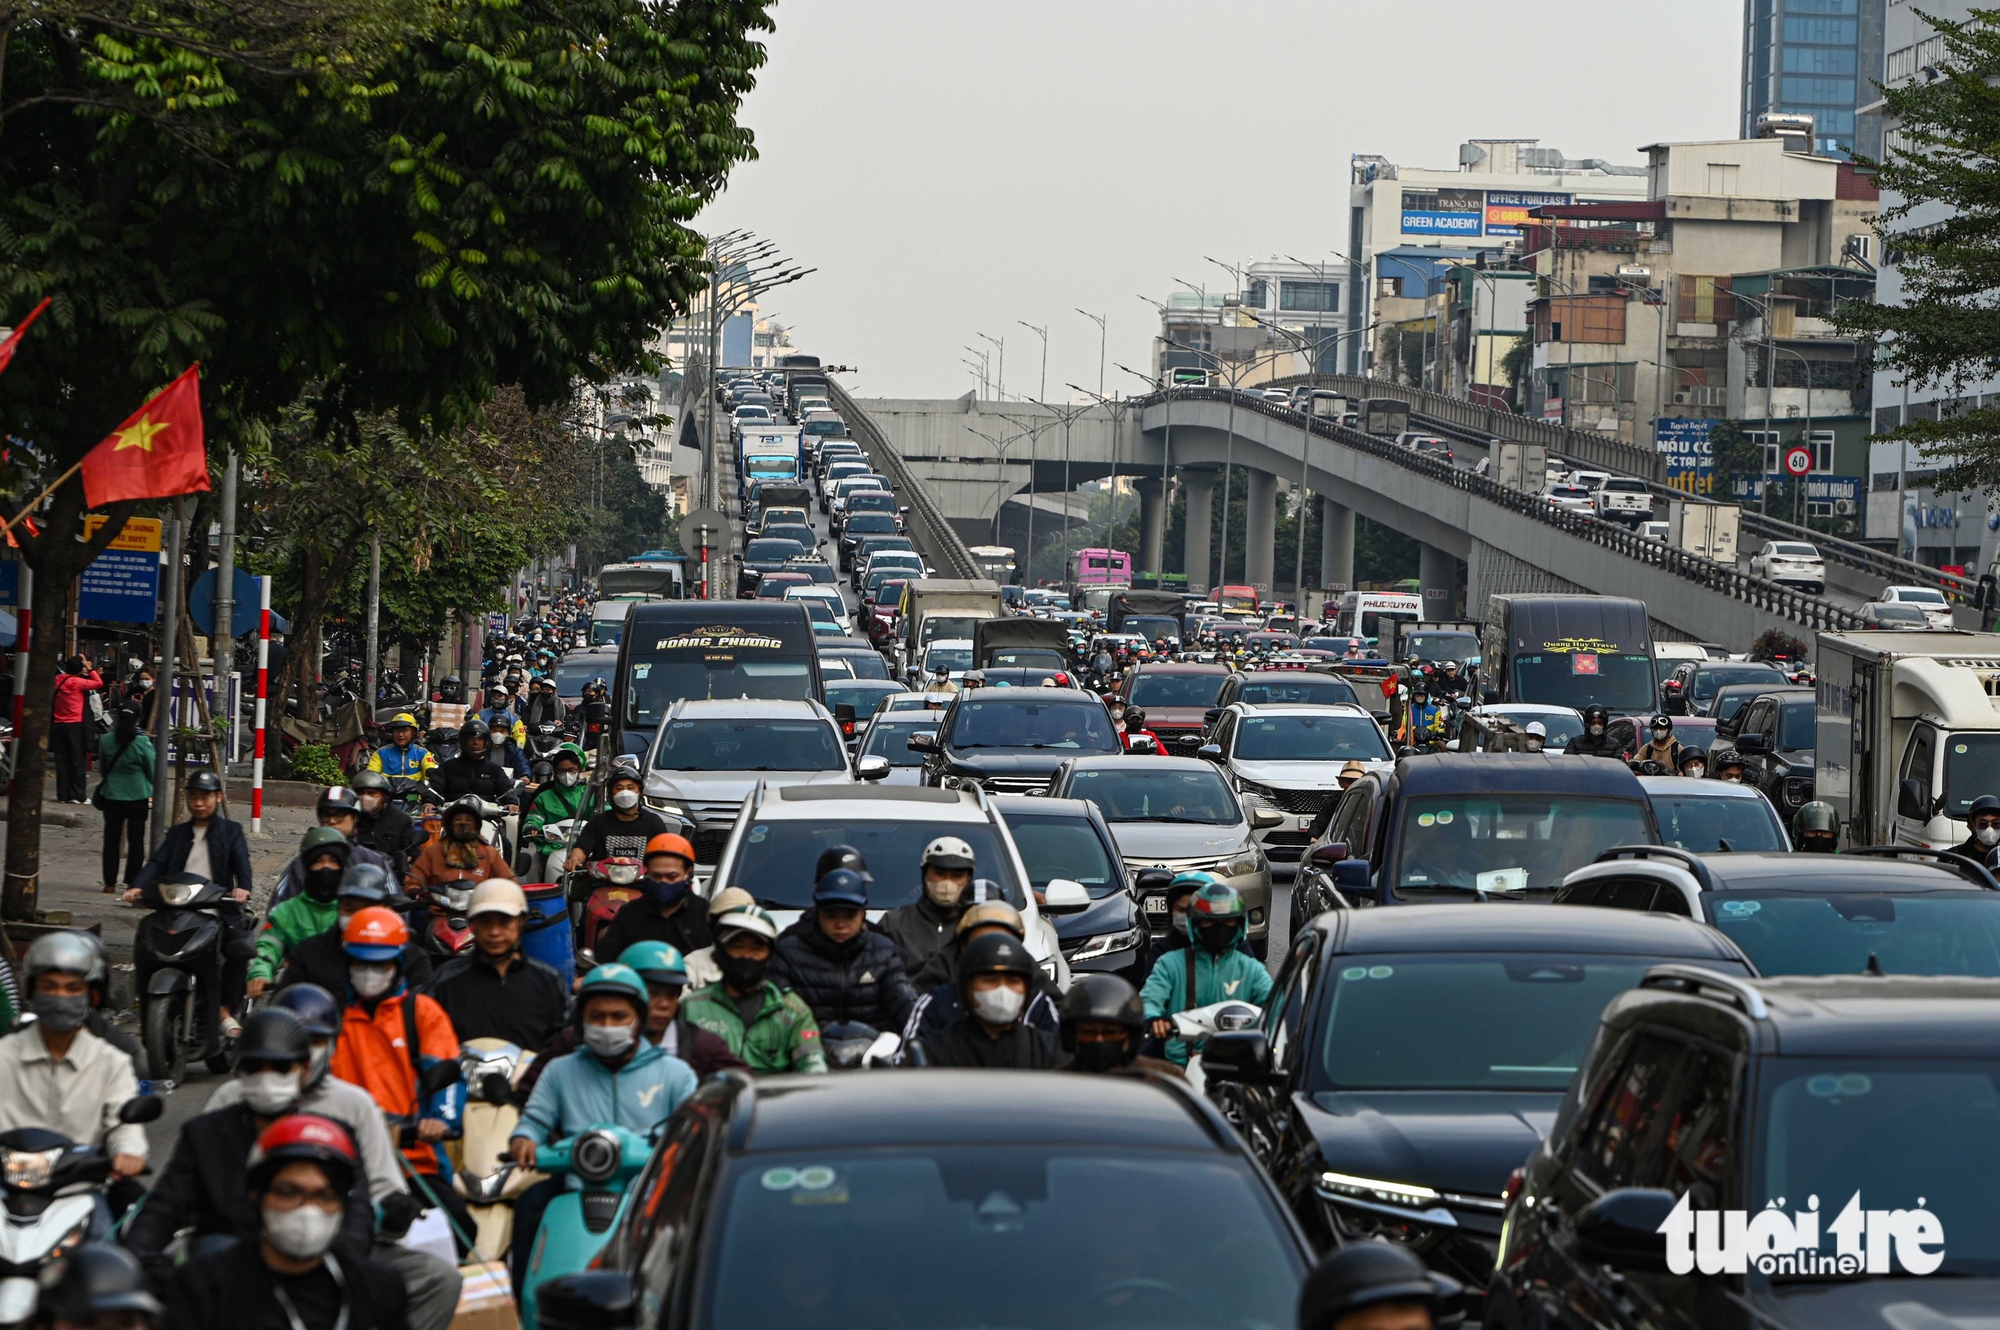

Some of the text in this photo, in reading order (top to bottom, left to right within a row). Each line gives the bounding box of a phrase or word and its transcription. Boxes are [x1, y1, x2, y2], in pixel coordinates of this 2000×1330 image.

[1490, 194, 1520, 204] OFFICE
[1403, 216, 1479, 229] GREEN ACADEMY
[1679, 456, 1696, 468] TẠI
[1792, 456, 1805, 468] 60
[1667, 471, 1714, 495] uffet
[1808, 479, 1828, 497] MÓN
[1830, 480, 1854, 499] NHẬU
[656, 638, 782, 650] HOÀNG PHƯƠNG
[409, 759, 419, 768] be
